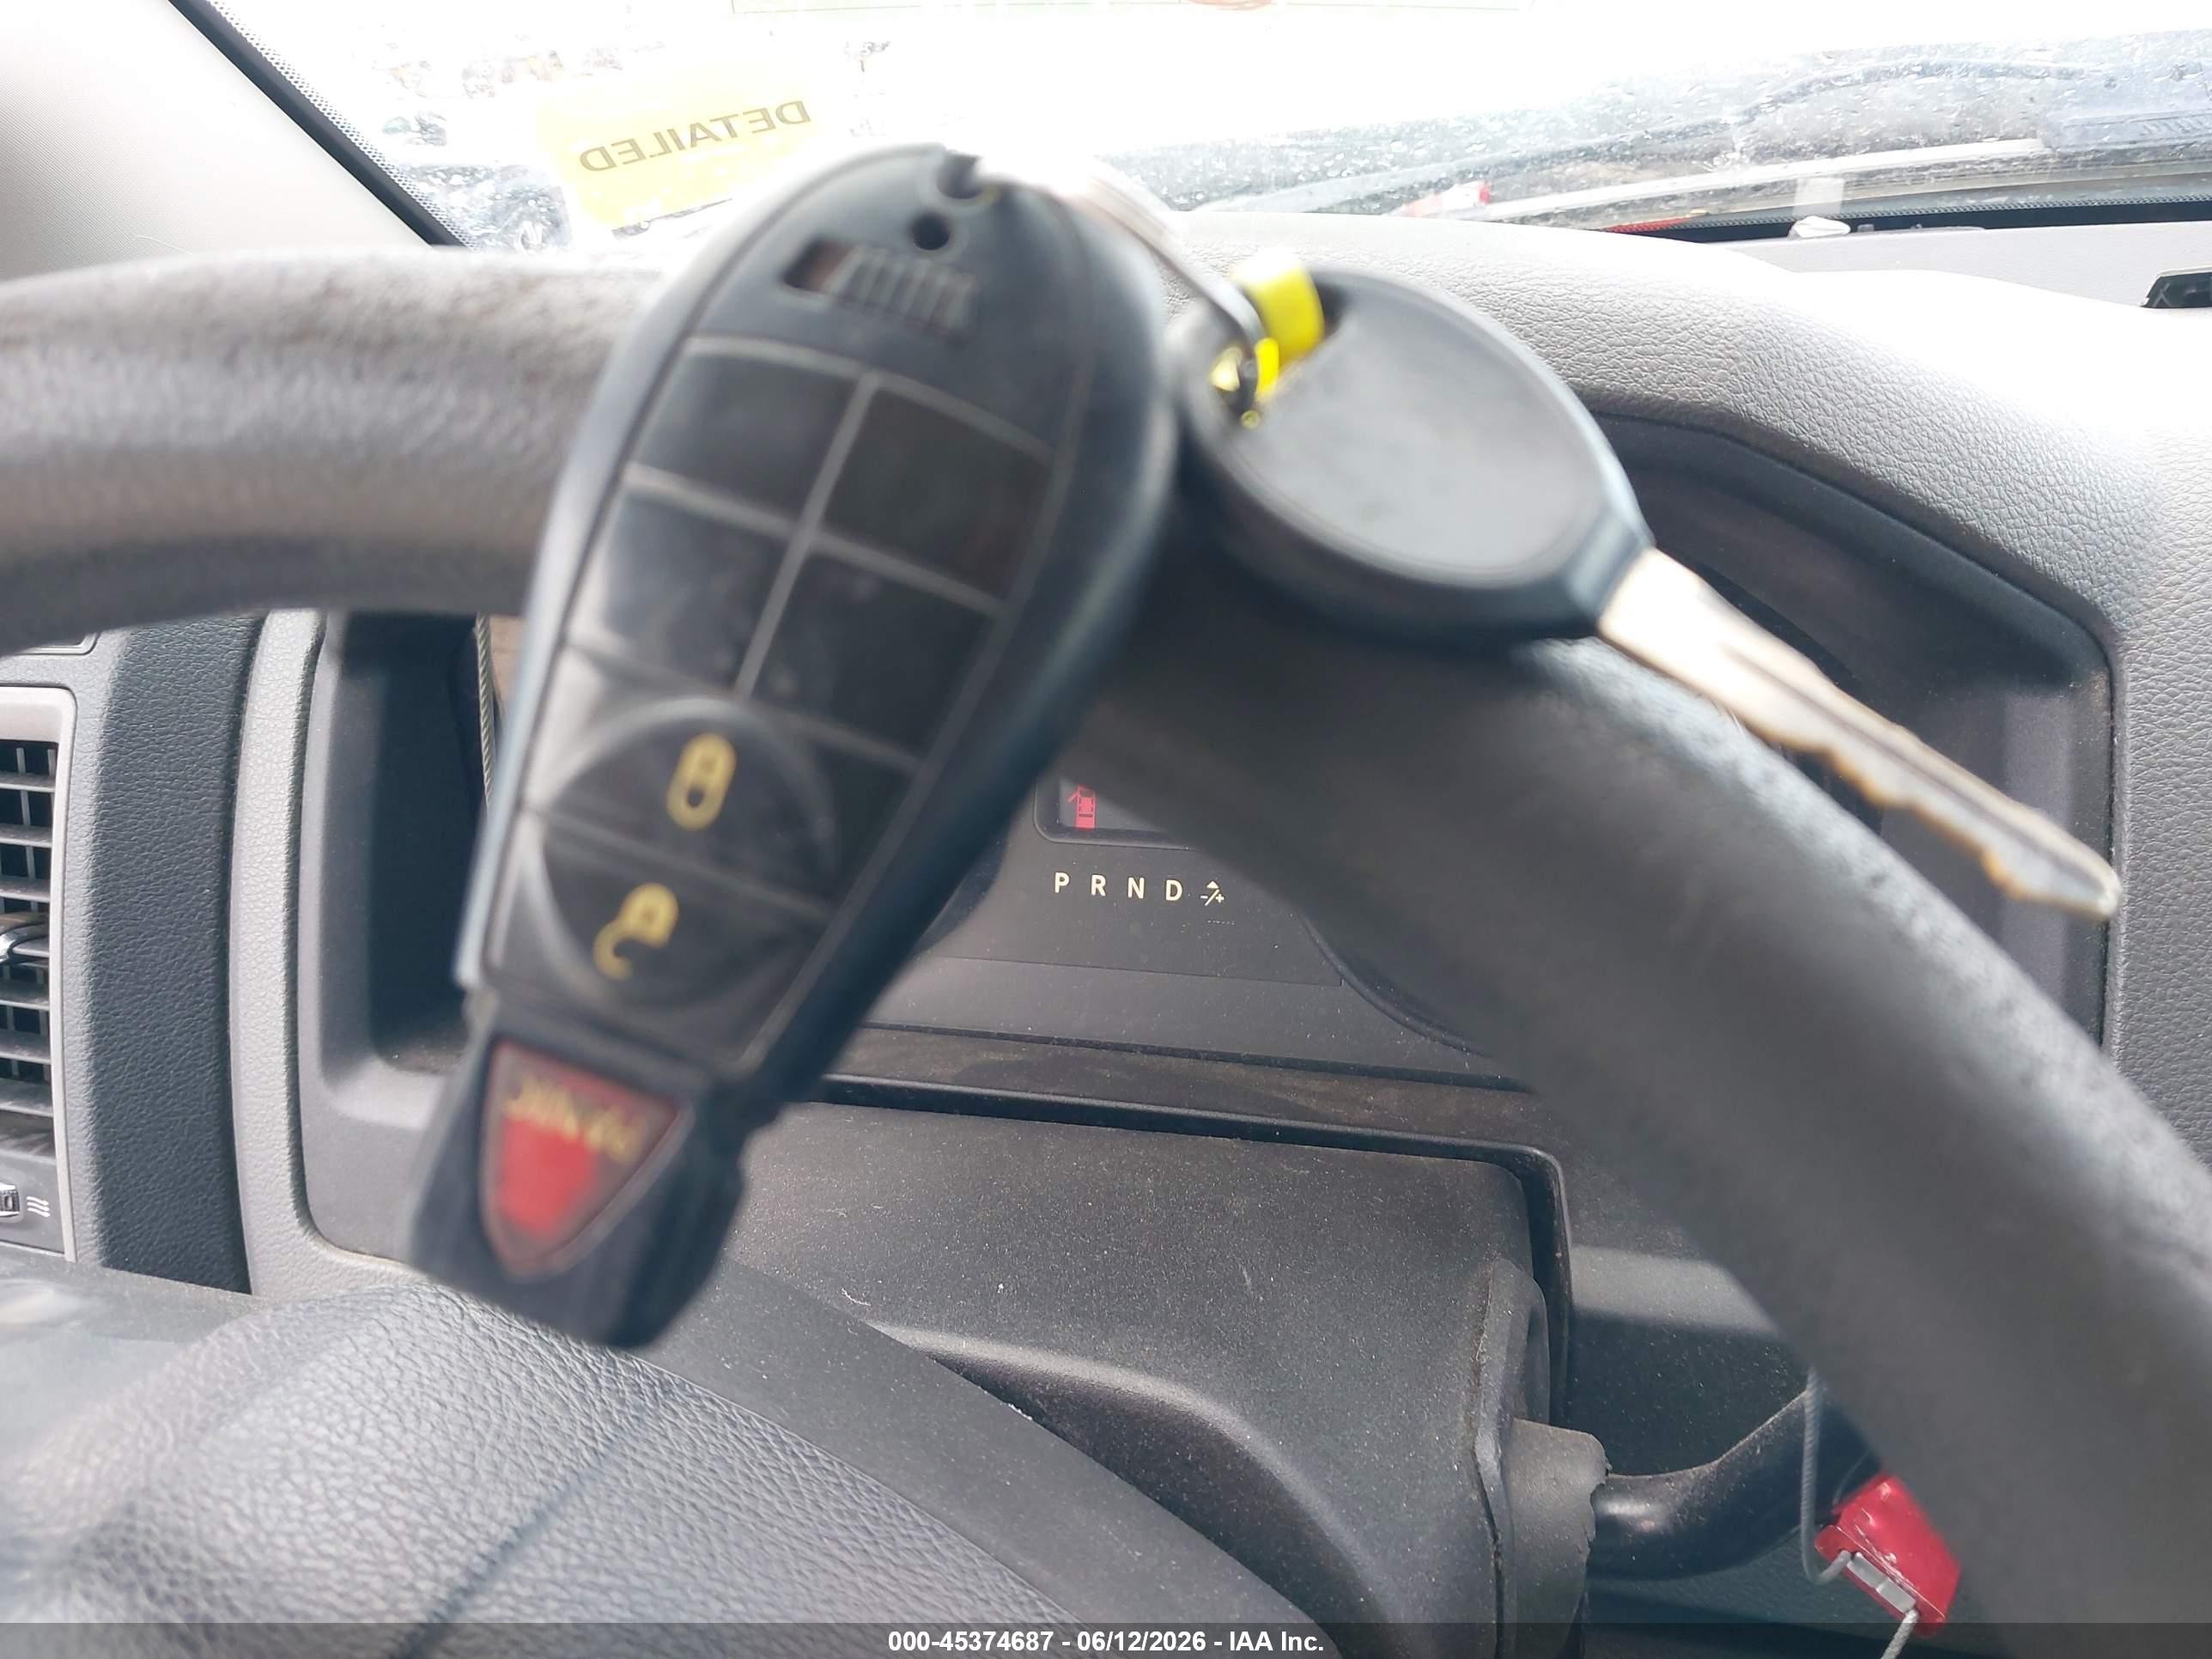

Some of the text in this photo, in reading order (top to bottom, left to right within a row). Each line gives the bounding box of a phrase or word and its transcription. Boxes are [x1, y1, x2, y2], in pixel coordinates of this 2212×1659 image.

[1054, 872, 1183, 902] P R N D
